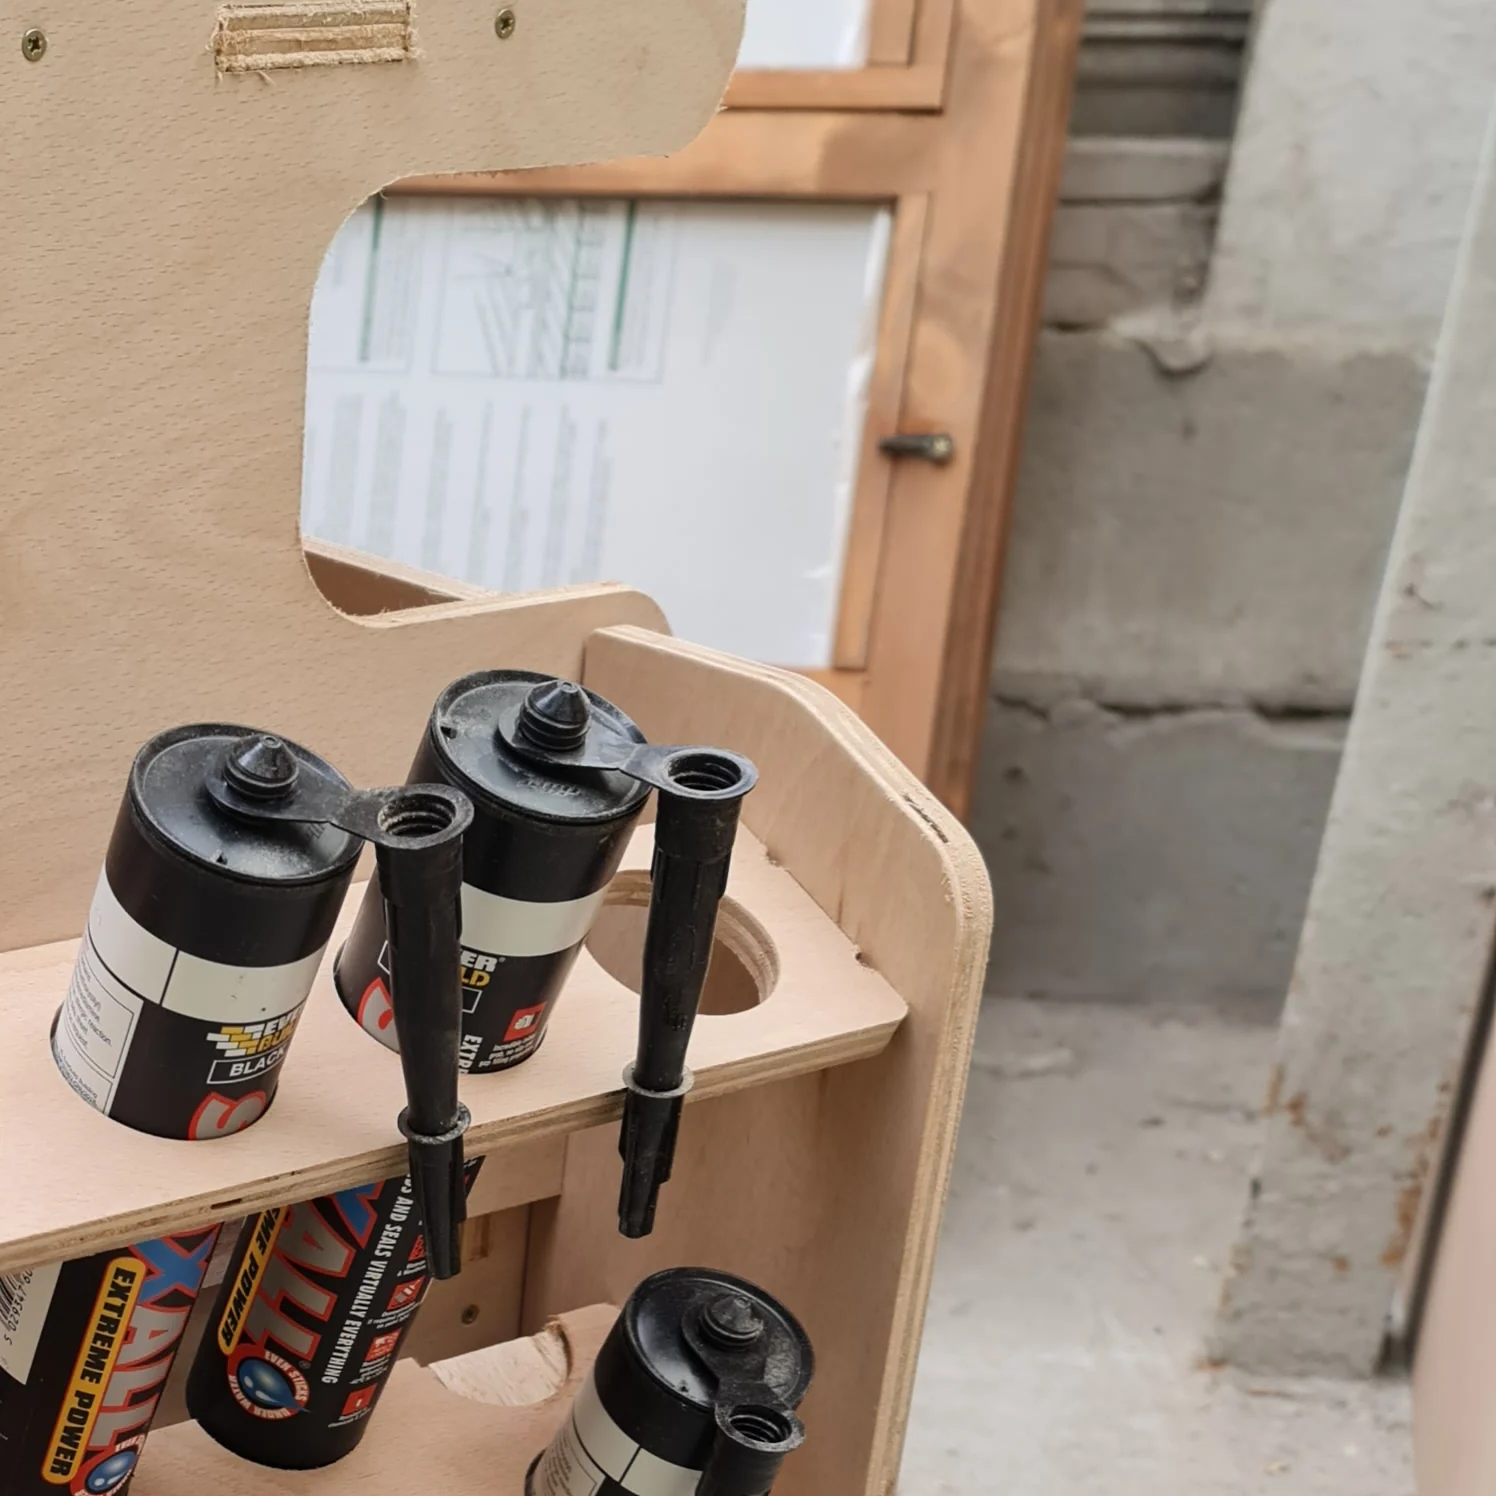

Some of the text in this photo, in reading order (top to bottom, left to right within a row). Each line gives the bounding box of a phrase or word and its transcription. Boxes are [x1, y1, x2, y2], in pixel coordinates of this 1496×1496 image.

[460, 951, 499, 972] ER
[389, 1195, 414, 1223] AND
[374, 1222, 403, 1259] SEALS
[221, 1256, 259, 1348] POWER
[348, 1258, 387, 1319] VIRTUALLY
[49, 1266, 137, 1478] EXTREME POWER
[321, 1318, 362, 1385] EVERYTHING
